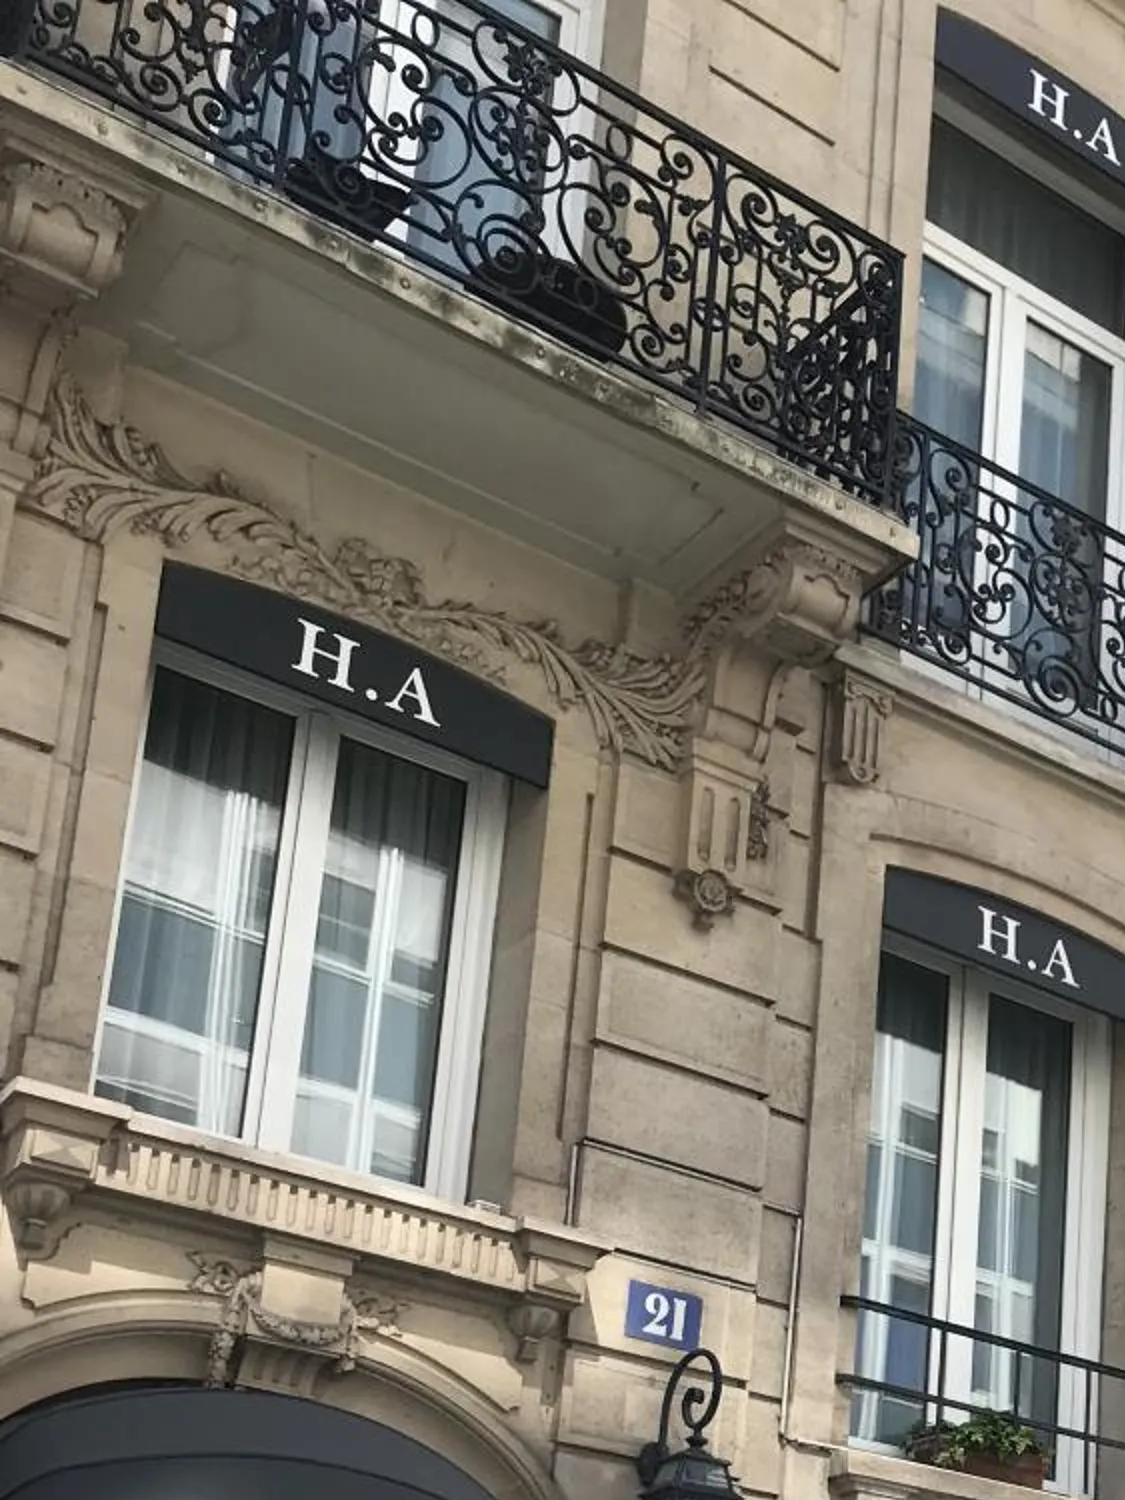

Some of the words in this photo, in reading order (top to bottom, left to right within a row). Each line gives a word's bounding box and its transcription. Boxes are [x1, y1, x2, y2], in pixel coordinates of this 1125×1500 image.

[1027, 68, 1121, 167] H.A
[291, 617, 441, 727] H.A
[977, 905, 1080, 988] H.A
[641, 1291, 687, 1342] 21
